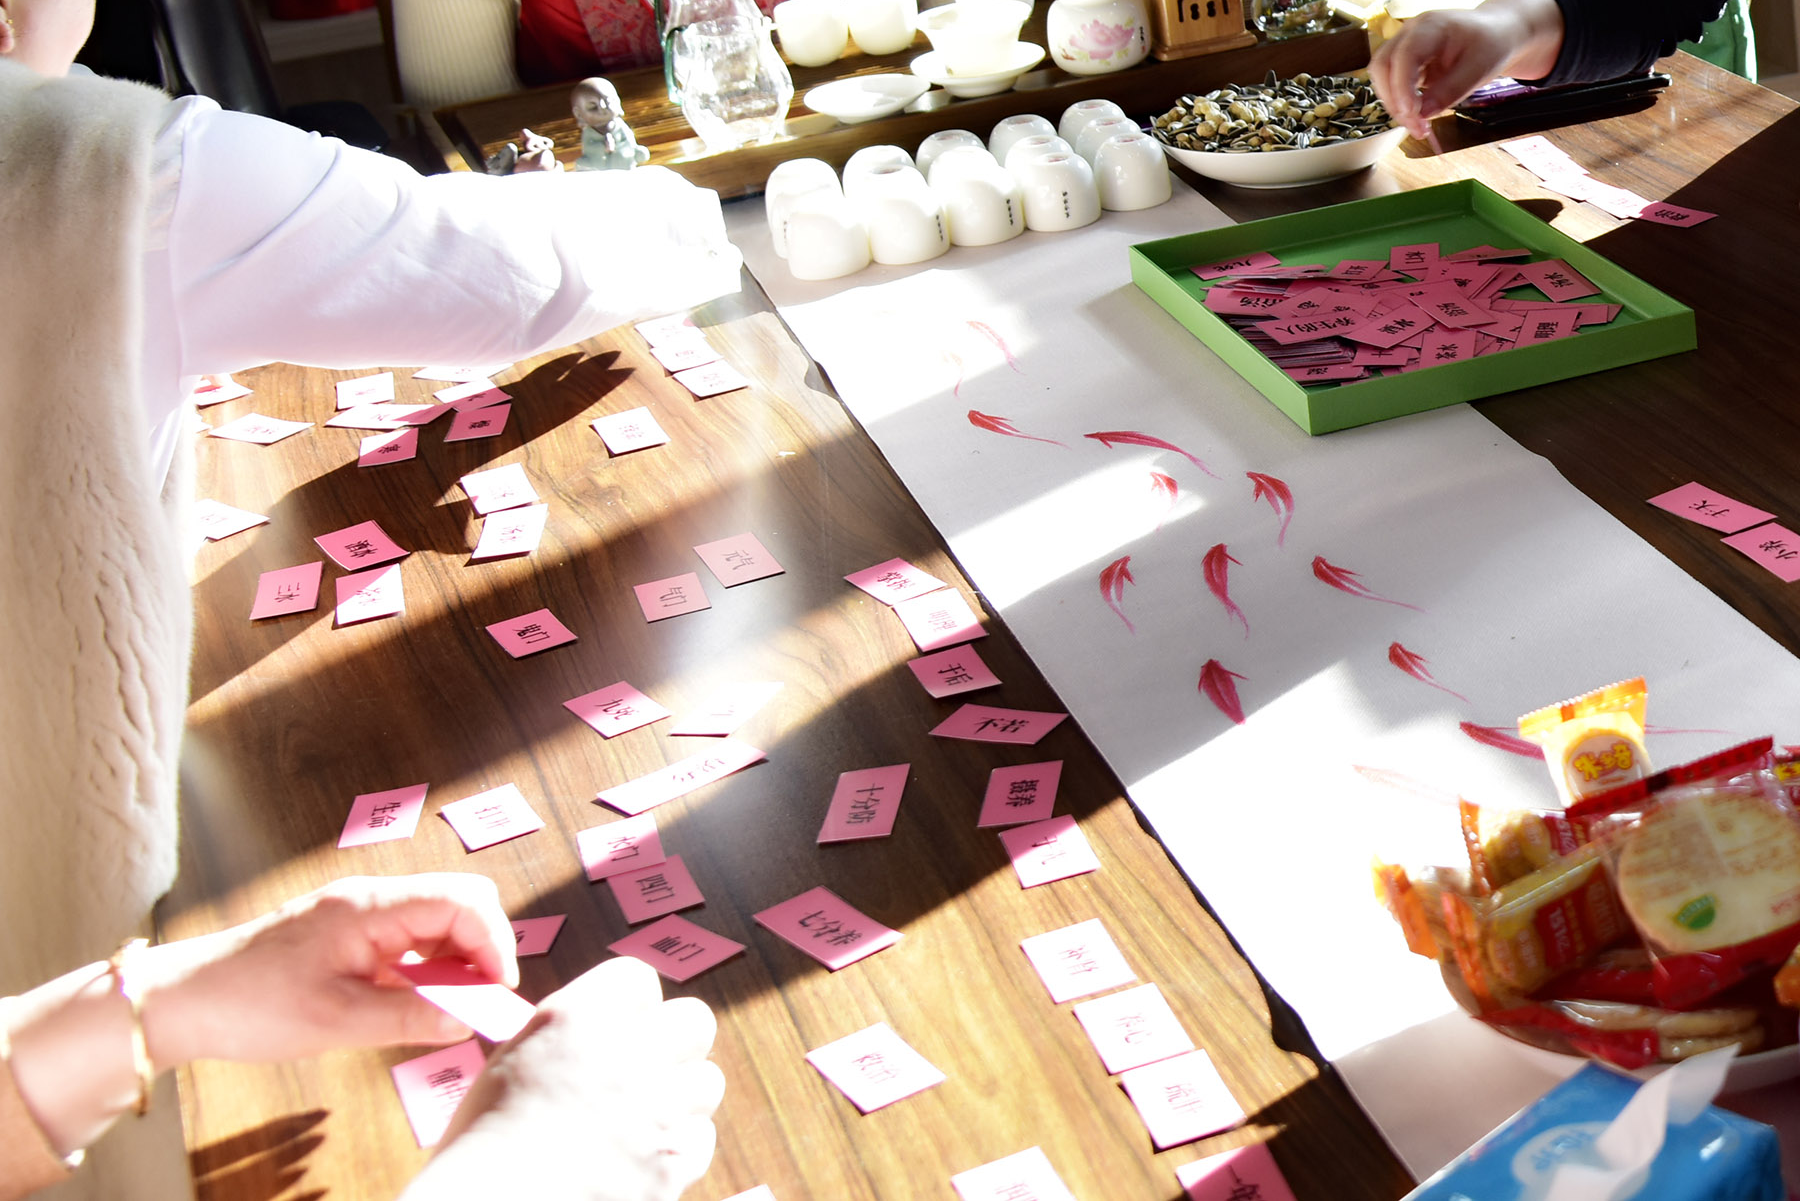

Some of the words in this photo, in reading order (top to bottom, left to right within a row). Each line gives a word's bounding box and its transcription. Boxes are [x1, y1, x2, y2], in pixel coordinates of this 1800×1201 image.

[1275, 315, 1356, 335] 养生的人
[1377, 319, 1415, 334] 酒水
[1435, 344, 1458, 360] 茶水
[723, 550, 754, 570] 元气
[1759, 540, 1798, 559] 小养
[514, 624, 550, 644] 鬼门
[938, 663, 973, 686] 于后
[975, 717, 1029, 734] 不若
[846, 784, 884, 824] 十分防
[368, 802, 401, 828] 生命
[608, 836, 639, 862] 水门
[637, 874, 675, 903] 四门
[798, 910, 862, 946] 七分养
[649, 936, 706, 962] 血门
